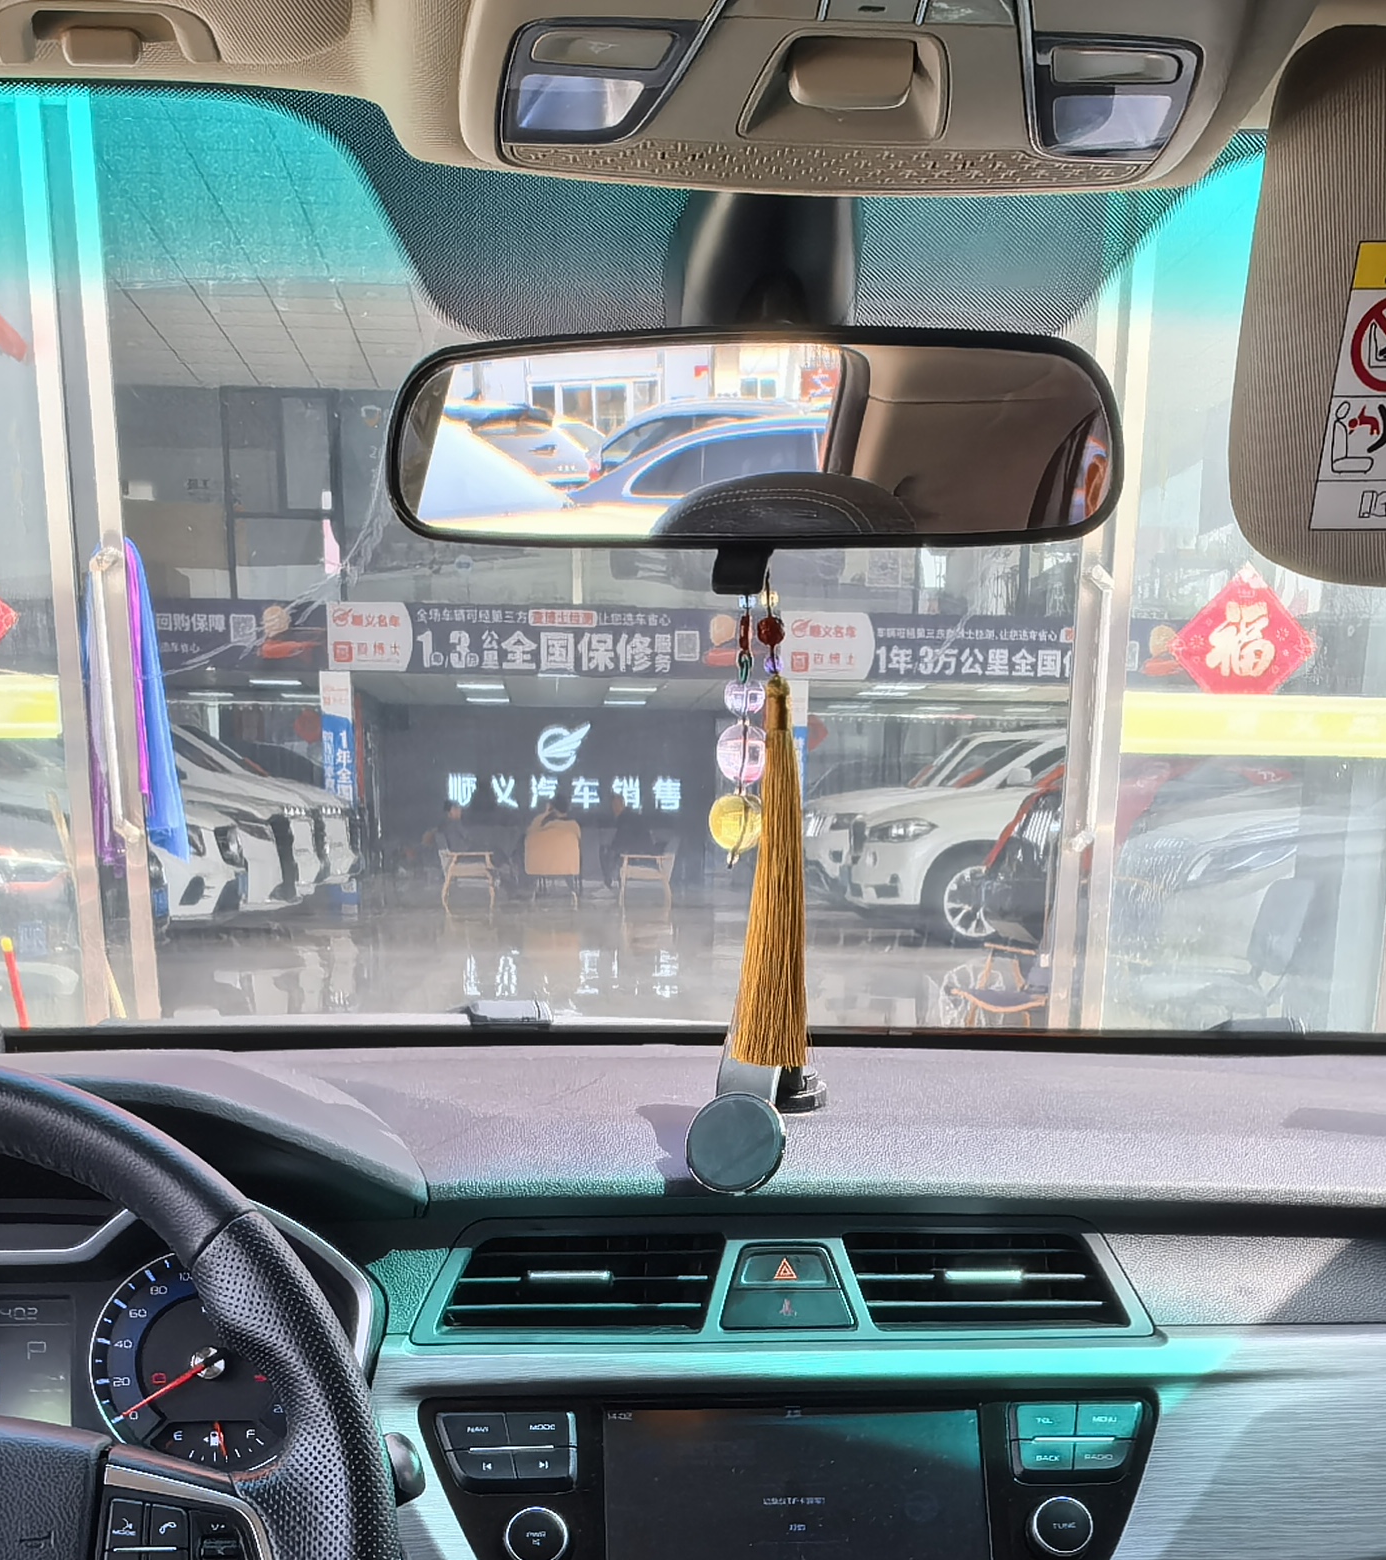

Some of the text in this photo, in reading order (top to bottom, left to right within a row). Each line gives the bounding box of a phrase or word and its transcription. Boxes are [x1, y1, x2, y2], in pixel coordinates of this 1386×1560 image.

[1205, 600, 1276, 678] 福
[447, 773, 682, 811] 顺义汽车销售
[150, 1286, 168, 1295] 80
[129, 1309, 147, 1318] 60
[114, 1340, 133, 1348] 40
[27, 1341, 47, 1360] P
[113, 1377, 130, 1386] 20
[173, 1431, 182, 1441] E
[246, 1429, 256, 1439] F
[1035, 1454, 1060, 1462] BACK
